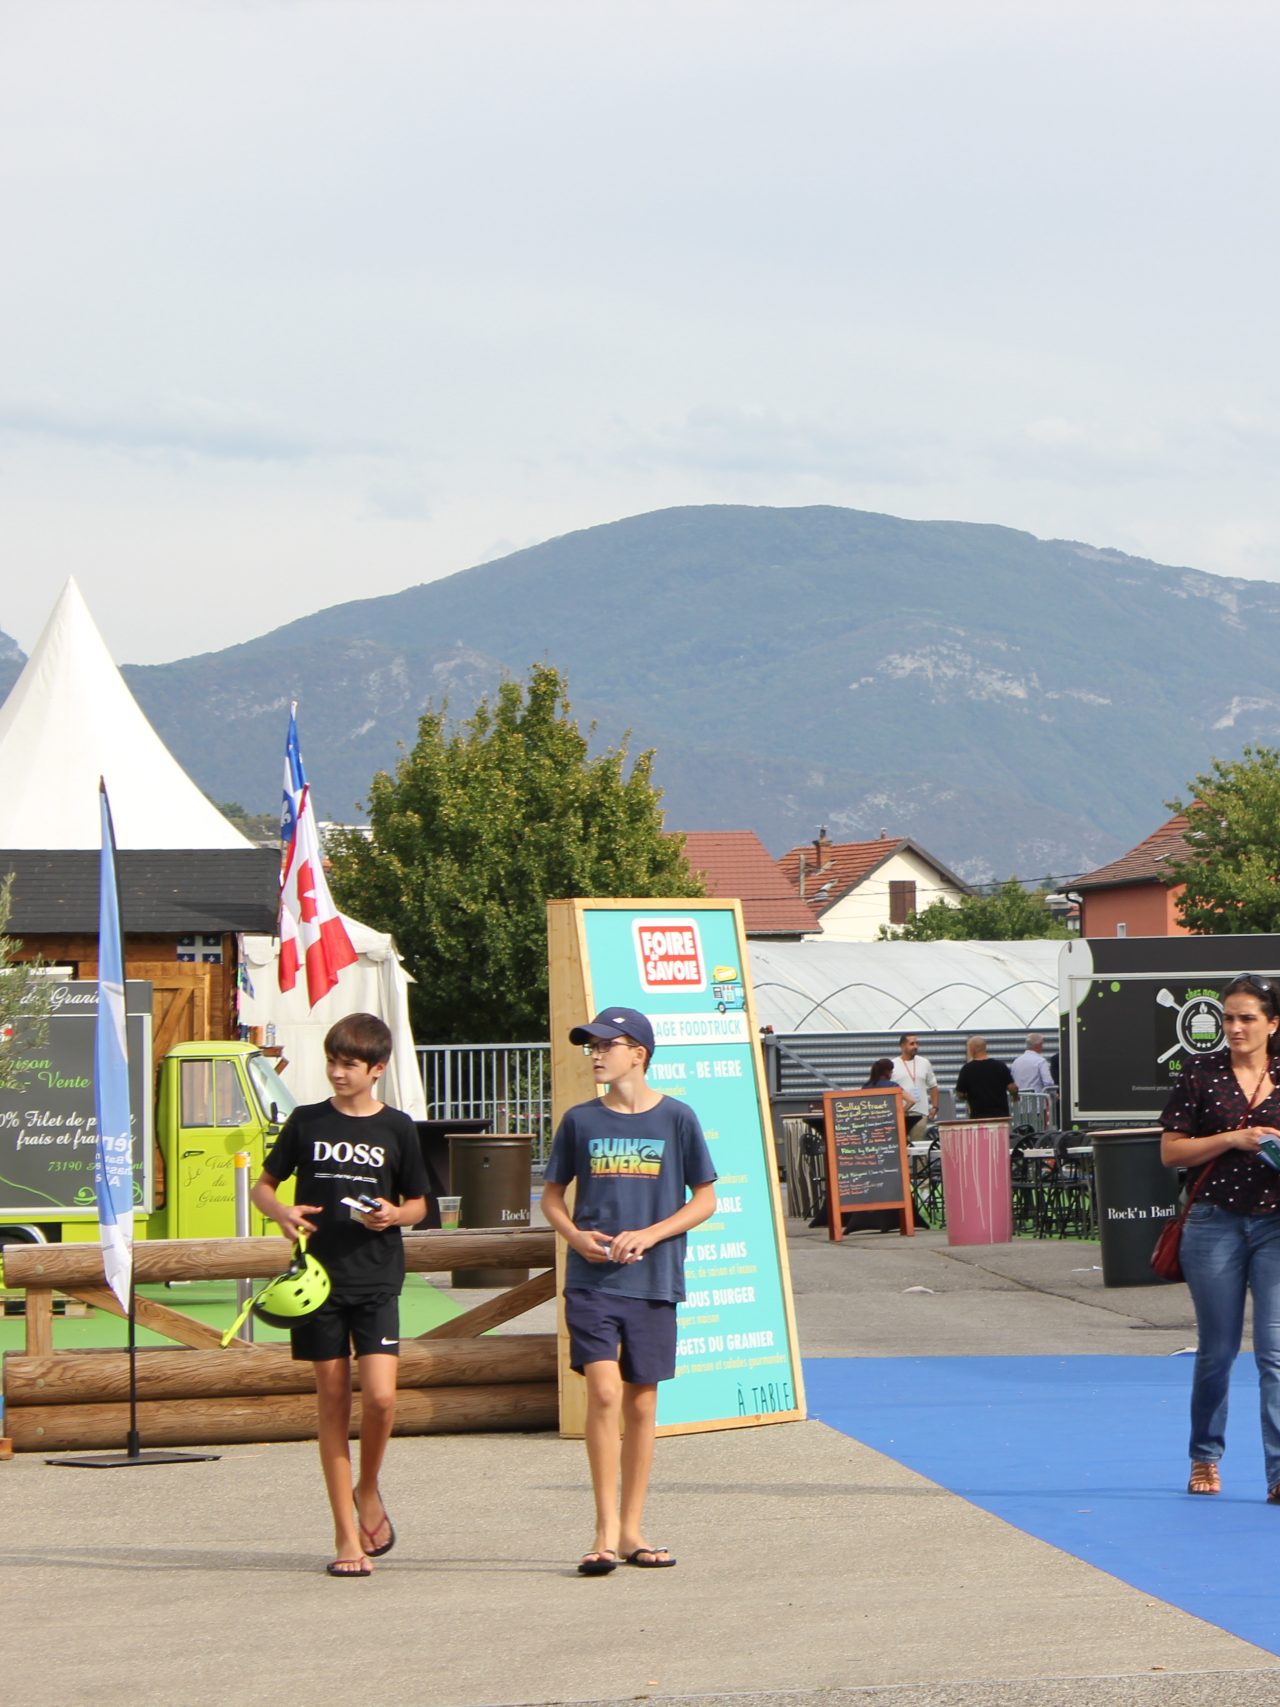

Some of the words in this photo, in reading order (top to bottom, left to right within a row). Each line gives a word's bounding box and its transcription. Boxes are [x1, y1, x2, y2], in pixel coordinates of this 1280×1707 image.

[640, 931, 696, 957] FOIRE
[646, 959, 699, 981] SAVOIE
[47, 986, 98, 1012] Grani
[680, 1019, 742, 1036] FOODTRUCK
[37, 1071, 91, 1088] Vente
[652, 1062, 688, 1080] TRUCK
[696, 1061, 711, 1079] BE
[713, 1059, 743, 1078] HERE
[25, 1110, 65, 1127] Filet
[65, 1112, 84, 1127] de
[16, 1129, 55, 1151] frais
[56, 1133, 72, 1145] et
[313, 1141, 385, 1168] DOSS
[48, 1161, 82, 1172] 73190
[1107, 1207, 1147, 1220] Rock'n
[1150, 1204, 1176, 1218] Baril
[697, 1244, 718, 1261] DES
[720, 1242, 747, 1259] AMIS
[713, 1286, 755, 1306] BURGER
[708, 1335, 724, 1352] DU
[727, 1331, 774, 1351] GRANIER
[738, 1382, 747, 1416] À
